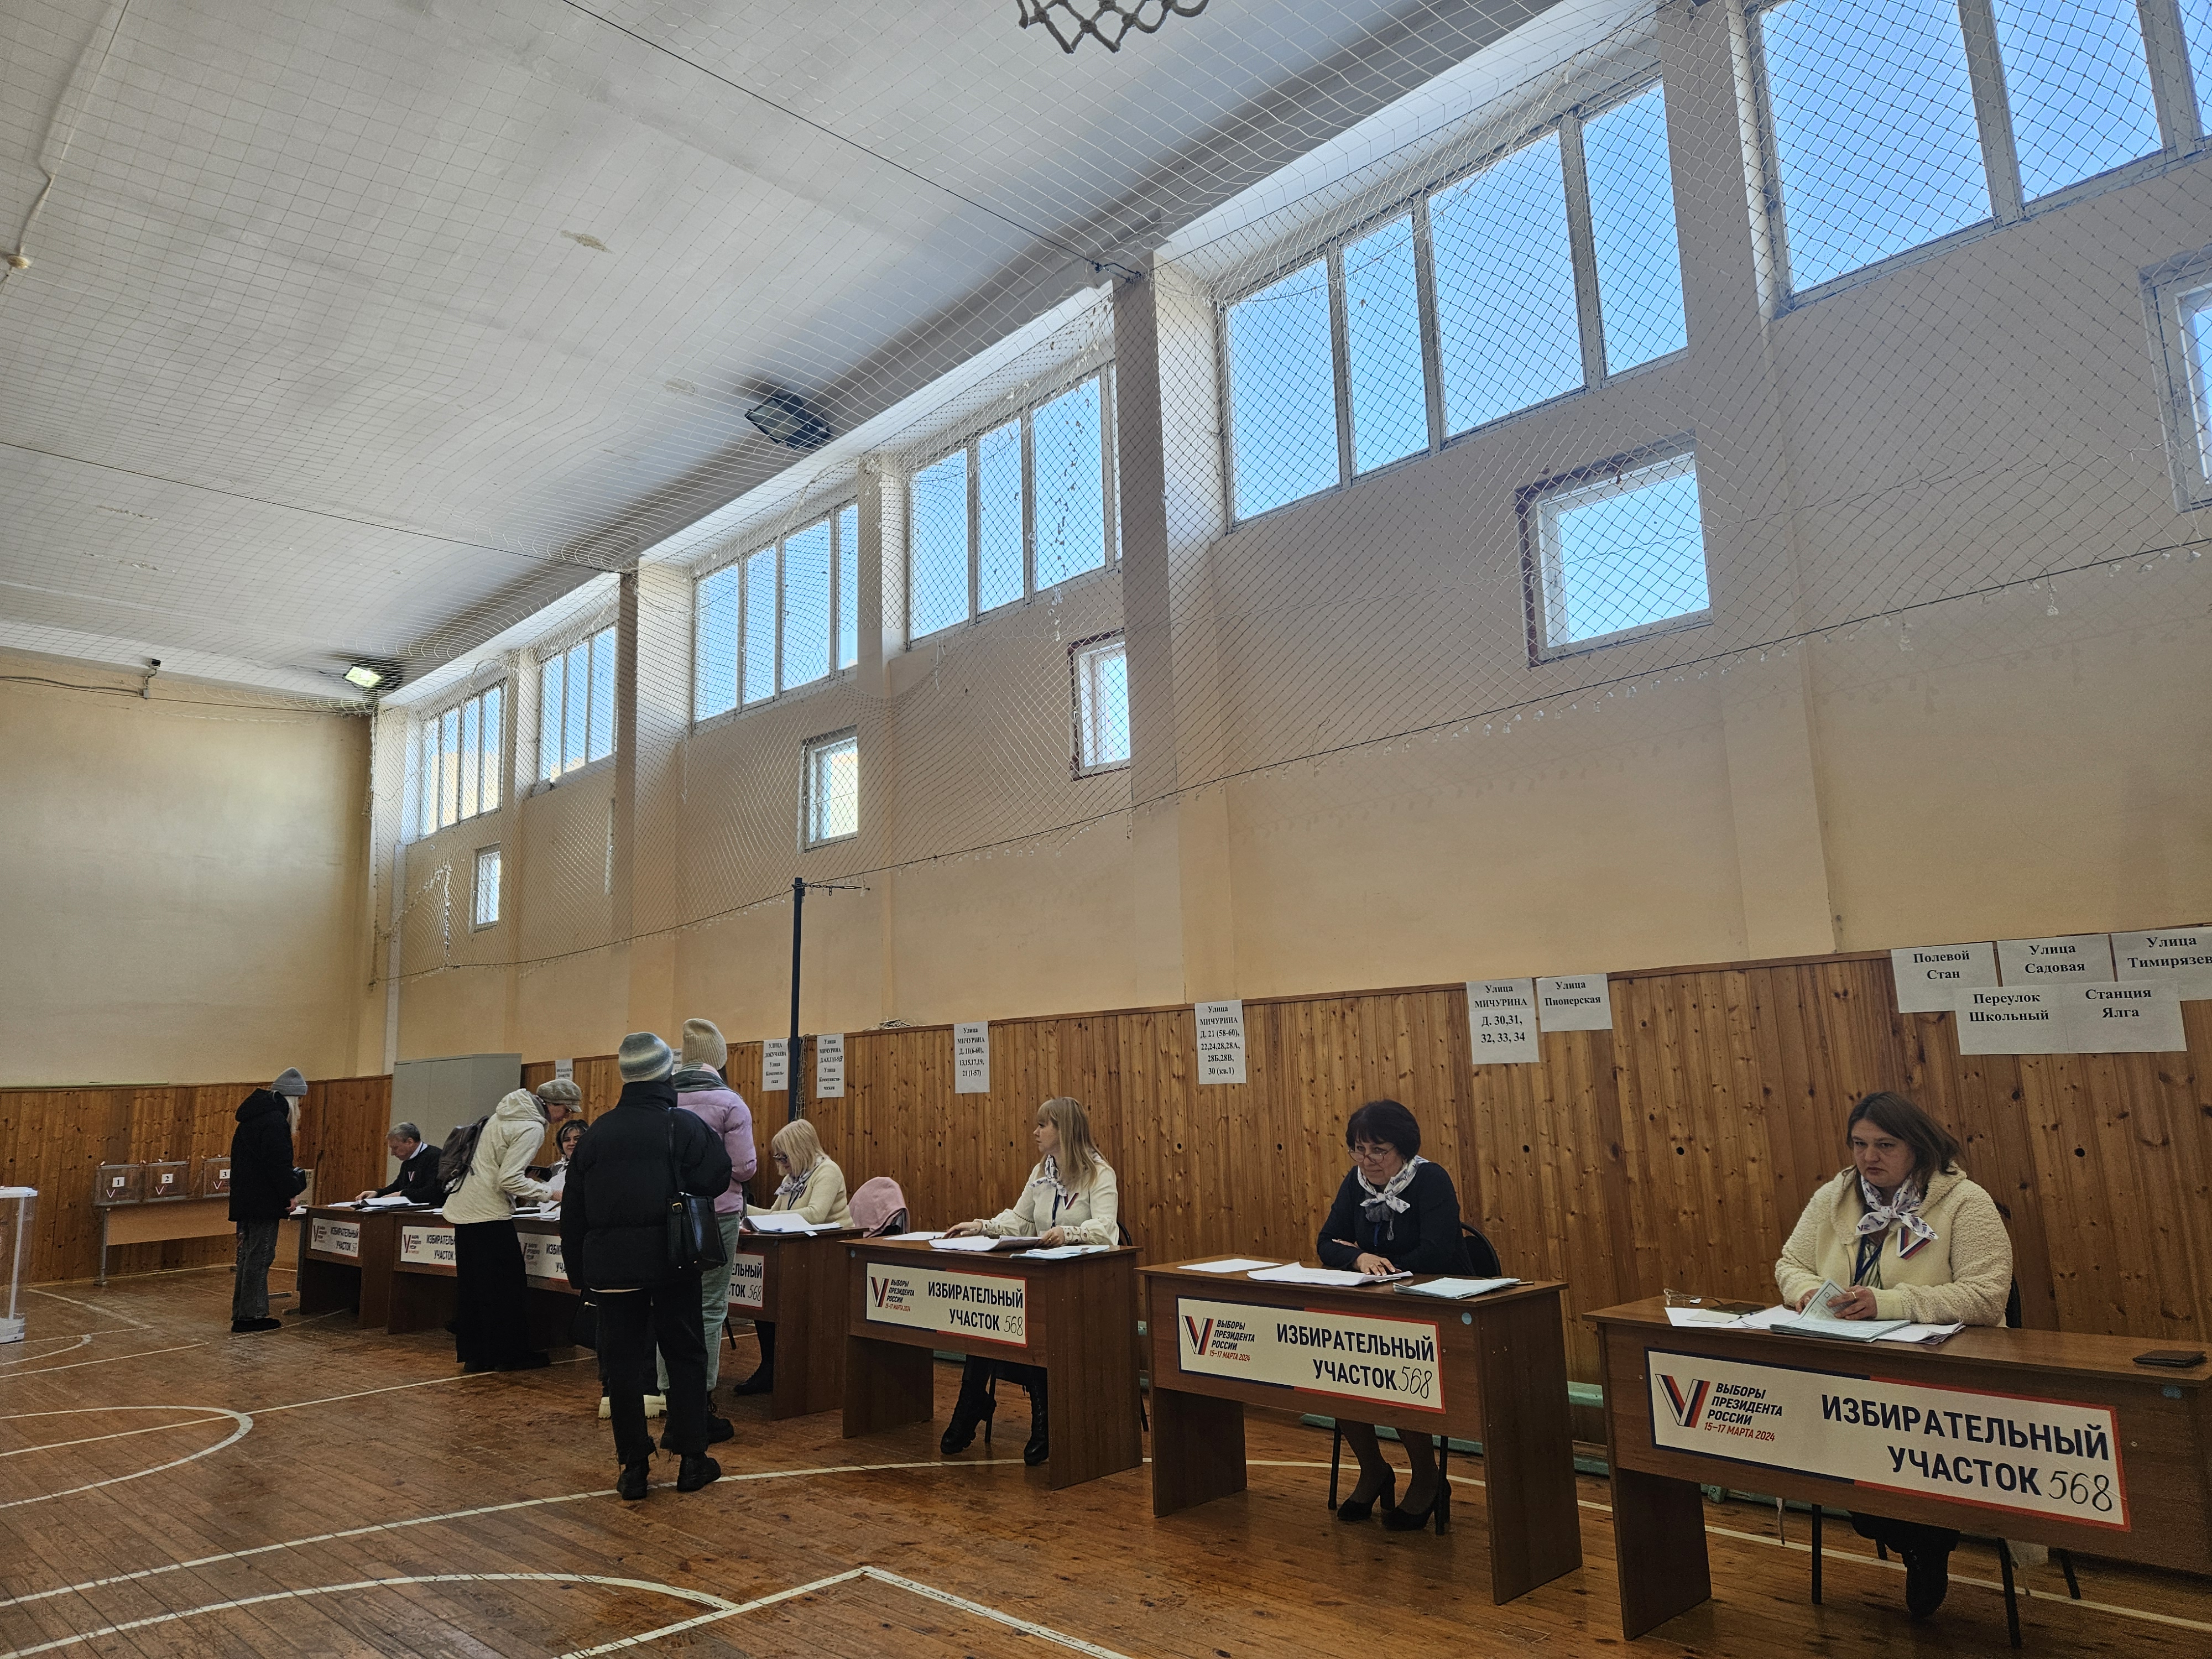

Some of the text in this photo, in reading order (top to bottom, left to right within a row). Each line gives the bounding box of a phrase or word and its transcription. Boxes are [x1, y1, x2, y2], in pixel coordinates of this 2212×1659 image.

[2146, 937, 2198, 948] Улица
[2028, 943, 2076, 956] Улица
[1913, 950, 1970, 964] Полевой
[1927, 968, 1960, 980] Стан
[2025, 962, 2085, 974] Садовая
[1485, 985, 1514, 993] Улица
[1555, 981, 1586, 990] Улица
[1973, 992, 2041, 1005] Переулок
[2085, 988, 2152, 1000] Станция
[1474, 998, 1527, 1008] МИЧУРИНА
[1545, 997, 1601, 1007] Пионерская
[1969, 1009, 2049, 1022] Школьный
[2102, 1006, 2140, 1019] Ялга
[1200, 1016, 1238, 1025] МИЧУРИНА
[1481, 1015, 1522, 1027] Д. 30,31,
[1200, 1031, 1207, 1039] Д.
[1217, 1029, 1240, 1039] (58-60),
[1481, 1032, 1525, 1045] 32, 33, 34
[1208, 1054, 1234, 1063] 28Б,28В,
[1217, 1067, 1234, 1076] (кв.1)
[890, 1279, 909, 1287] ВЫБОРЫ
[748, 1285, 762, 1301] 568
[888, 1287, 915, 1297] ПРЕЗИДЕНТА
[928, 1281, 1023, 1308] ИЗБИРАТЕЛЬНЫЙ
[886, 1295, 904, 1303] РОССИИ
[949, 1308, 1023, 1337] УЧАСТОК 568
[1217, 1319, 1246, 1330] ВЫБОРЫ
[1214, 1330, 1255, 1343] ПРЕЗИДЕНТА
[1276, 1323, 1435, 1362] ИЗБИРАТЕЛЬНЫЙ
[1211, 1340, 1238, 1351] РОССИИ
[1223, 1352, 1238, 1360] МАРТА
[1238, 1354, 1251, 1363] 2024
[1312, 1359, 1433, 1400] УЧАСТОК 568
[1715, 1383, 1767, 1400] ВЫБОРЫ
[1711, 1396, 1783, 1416] ПРЕЗИДЕНТА
[1707, 1409, 1752, 1426] РОССИИ
[1822, 1394, 2109, 1460] ИЗБИРАТЕЛЬНЫЙ
[1726, 1426, 1754, 1438] МАРТА
[1755, 1430, 1775, 1442] 2024
[1887, 1445, 2113, 1512] УЧАСТОК 568
